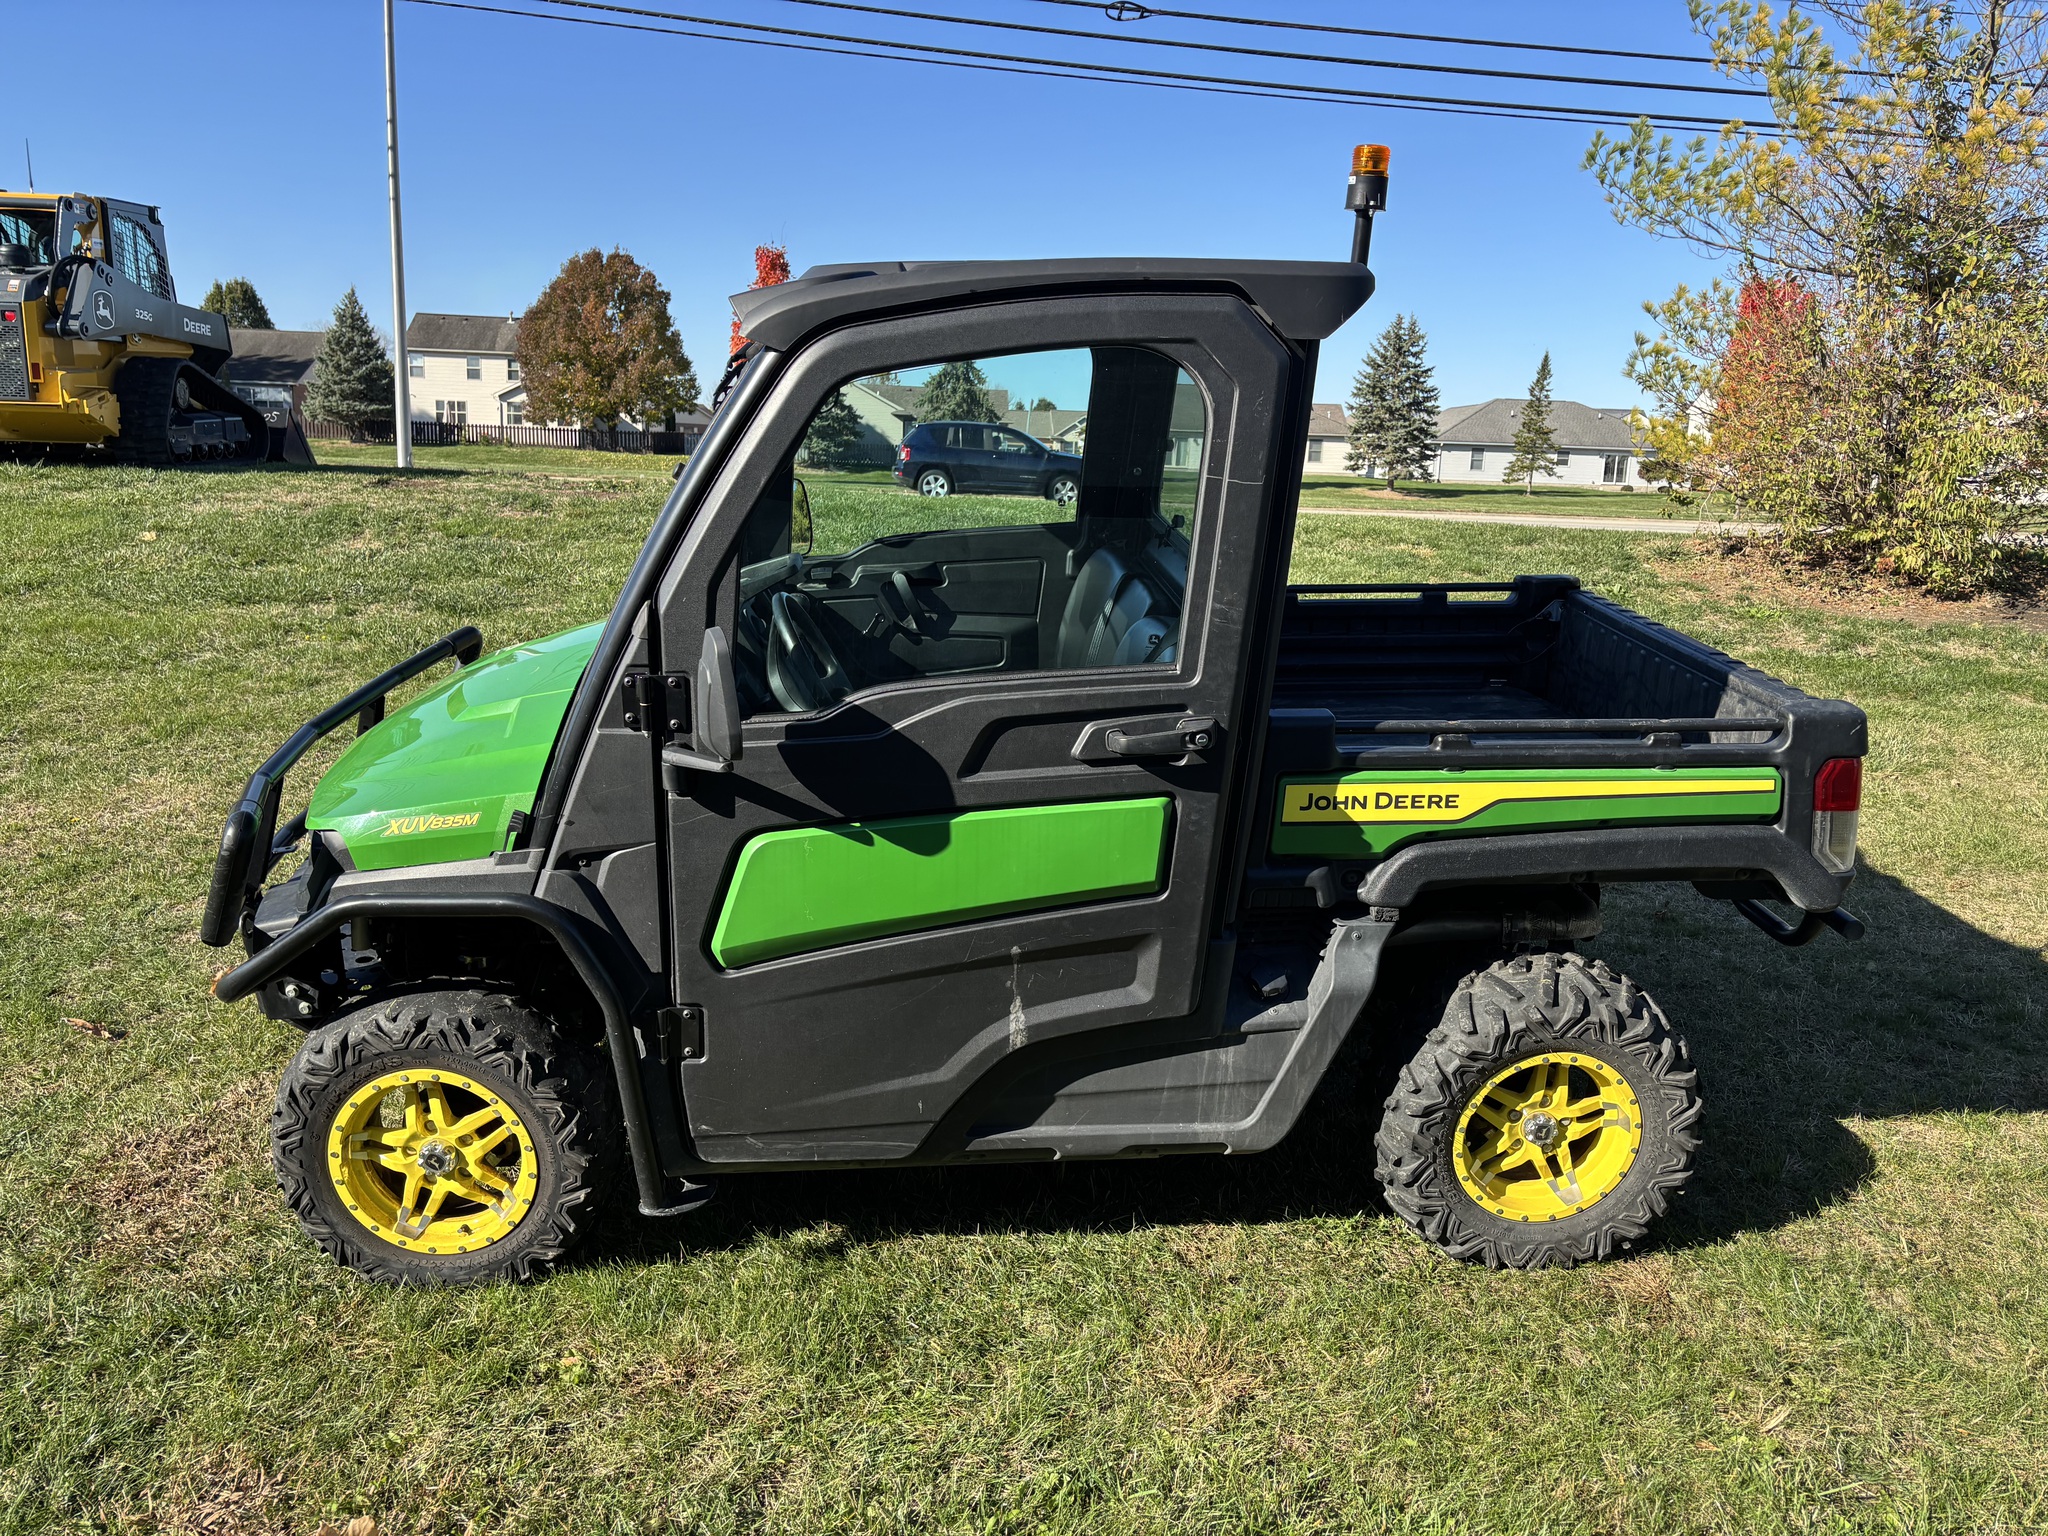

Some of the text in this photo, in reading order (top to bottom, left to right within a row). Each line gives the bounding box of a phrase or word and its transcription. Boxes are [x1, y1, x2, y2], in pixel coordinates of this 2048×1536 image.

[135, 308, 153, 322] 325G
[183, 317, 212, 336] DEERE
[1299, 791, 1460, 812] JOHN DEERE
[383, 812, 480, 837] XUV835M
